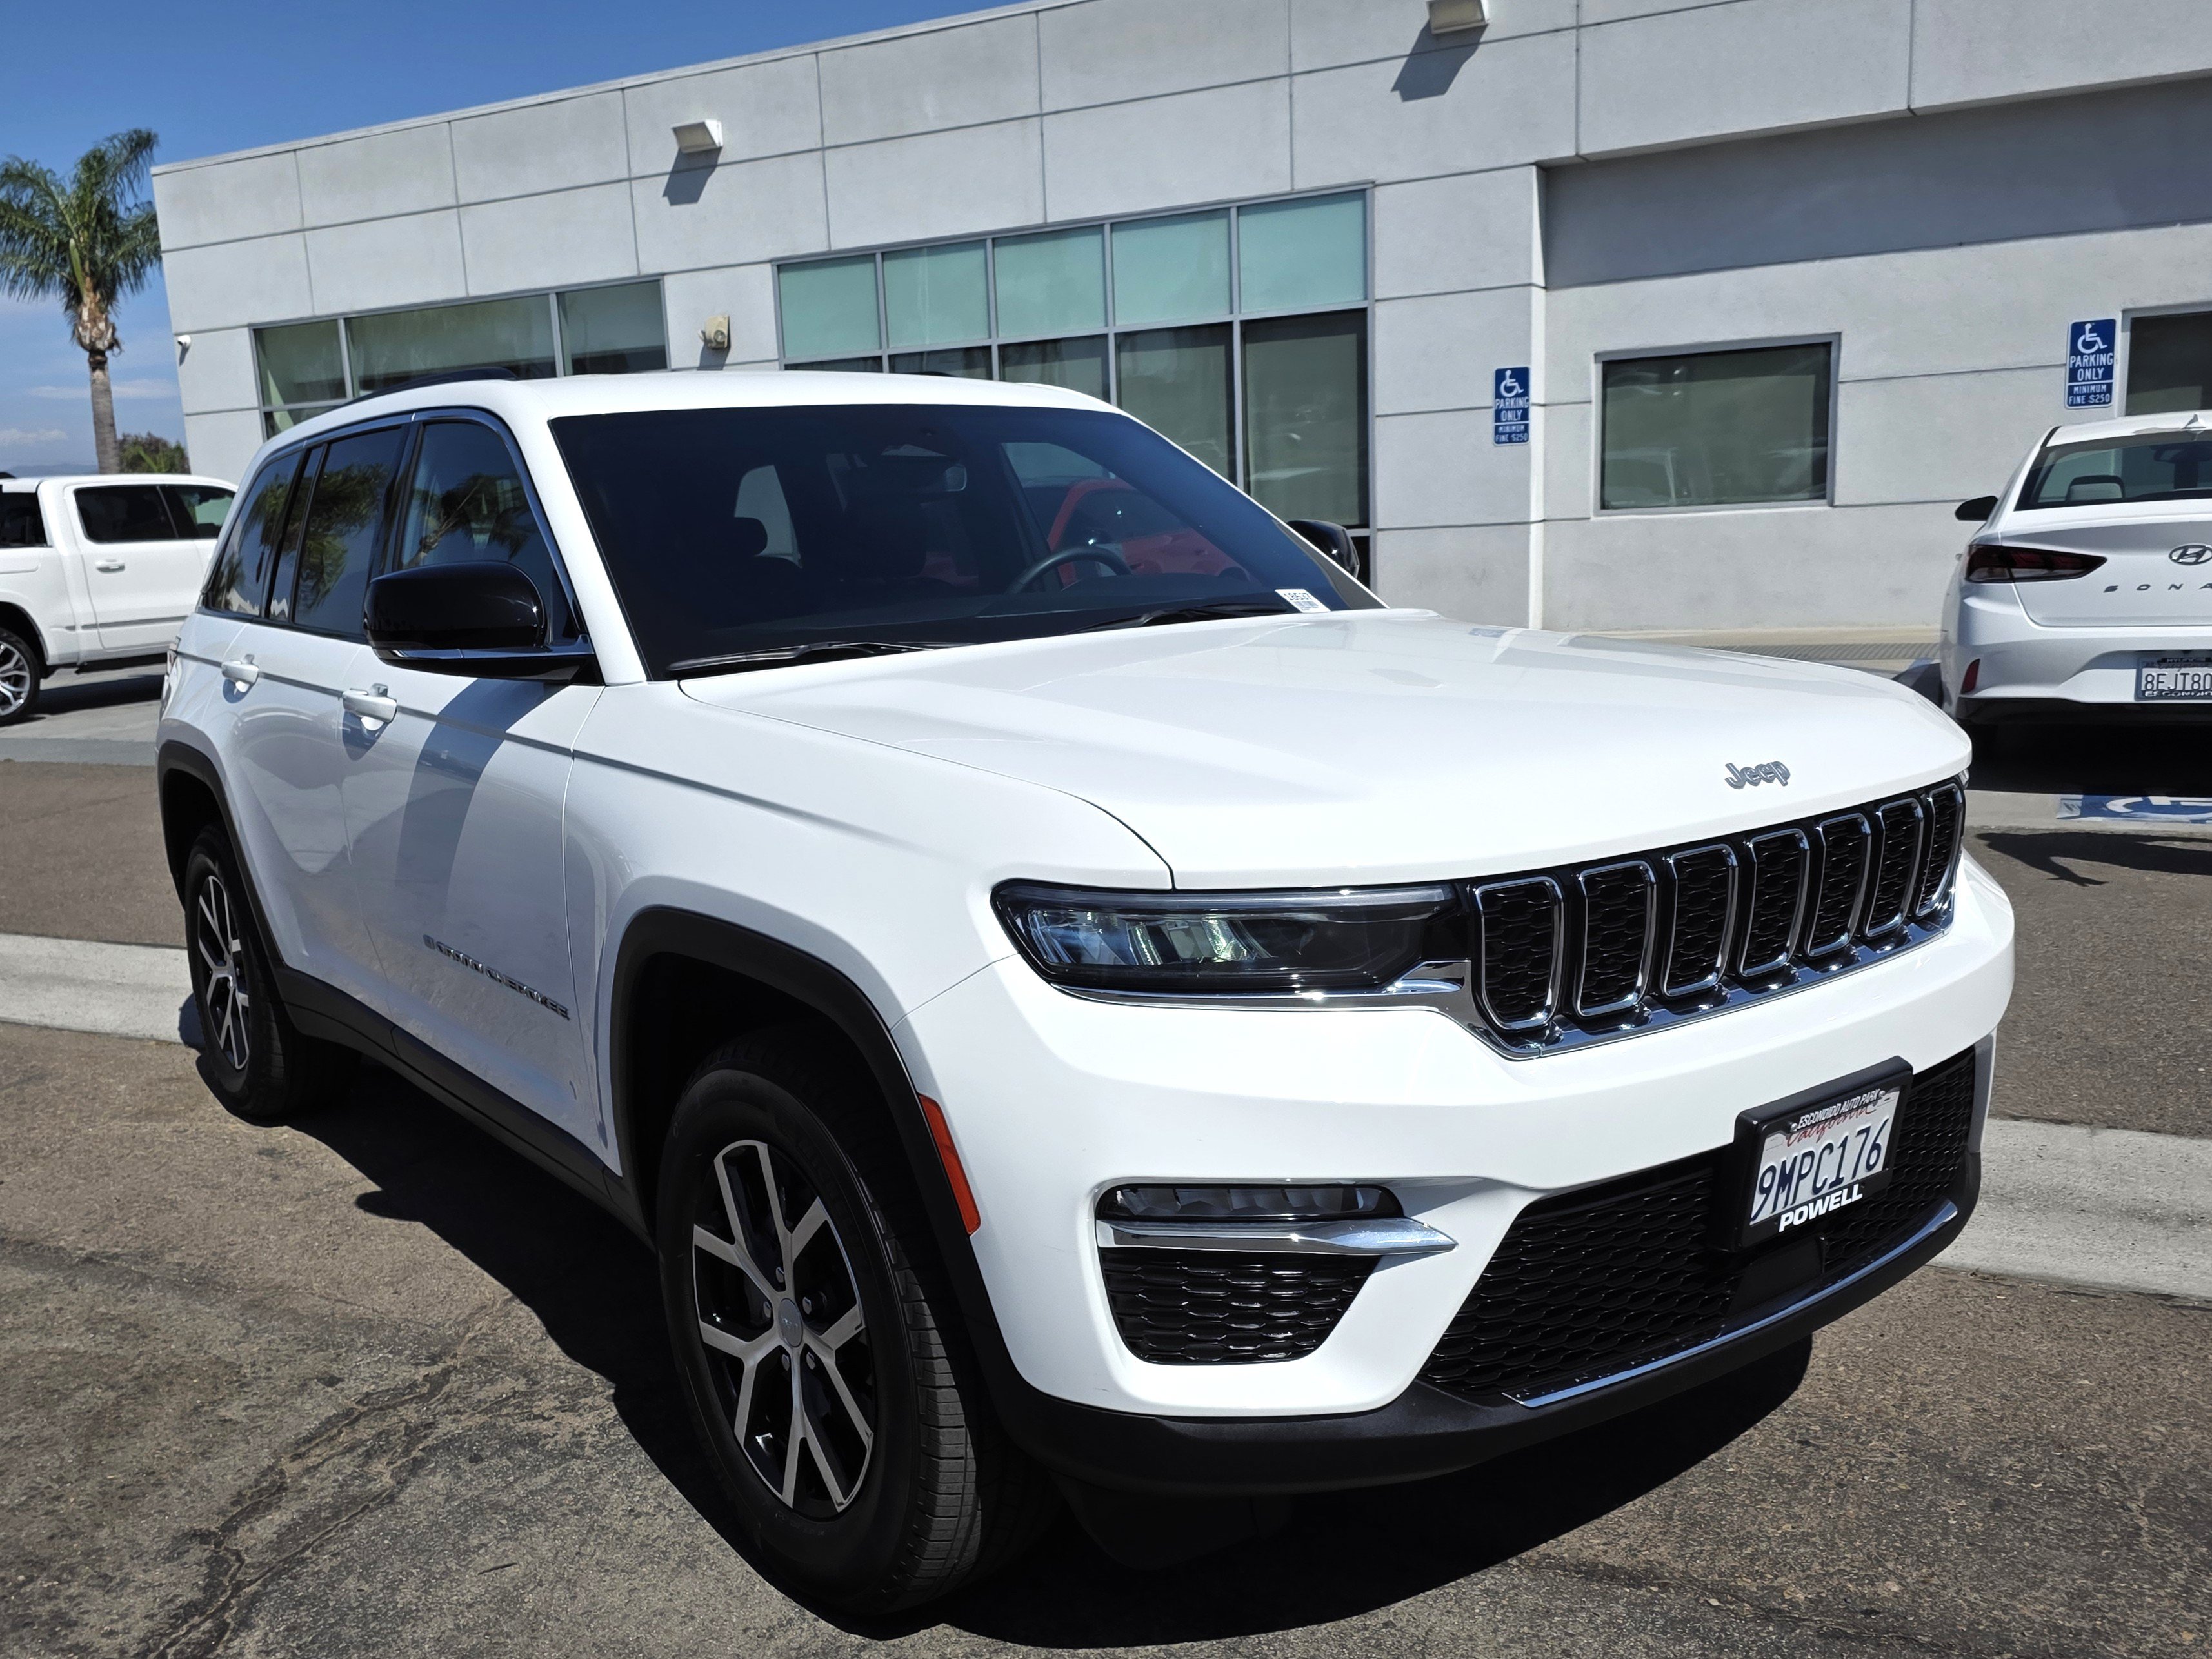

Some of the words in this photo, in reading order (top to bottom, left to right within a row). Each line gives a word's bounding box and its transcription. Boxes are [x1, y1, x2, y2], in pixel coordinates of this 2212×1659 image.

[2069, 353, 2113, 368] PARKING
[2077, 368, 2104, 381] ONLY
[2073, 385, 2107, 394] MINIMUM
[1495, 396, 1529, 410] PARKING
[2069, 395, 2086, 405] FINE
[2088, 394, 2110, 403] $250
[1500, 409, 1522, 421] ONLY
[1499, 425, 1525, 433] MINIMUM
[1495, 434, 1509, 442] FINE
[1724, 761, 1791, 790] Jeep
[1798, 1103, 1842, 1129] ESCONDIDO
[1839, 1096, 1862, 1114] AUTO
[1858, 1089, 1880, 1106] PARK
[1750, 1118, 1889, 1222] 9MPC176
[1779, 1183, 1863, 1232] POWELL
